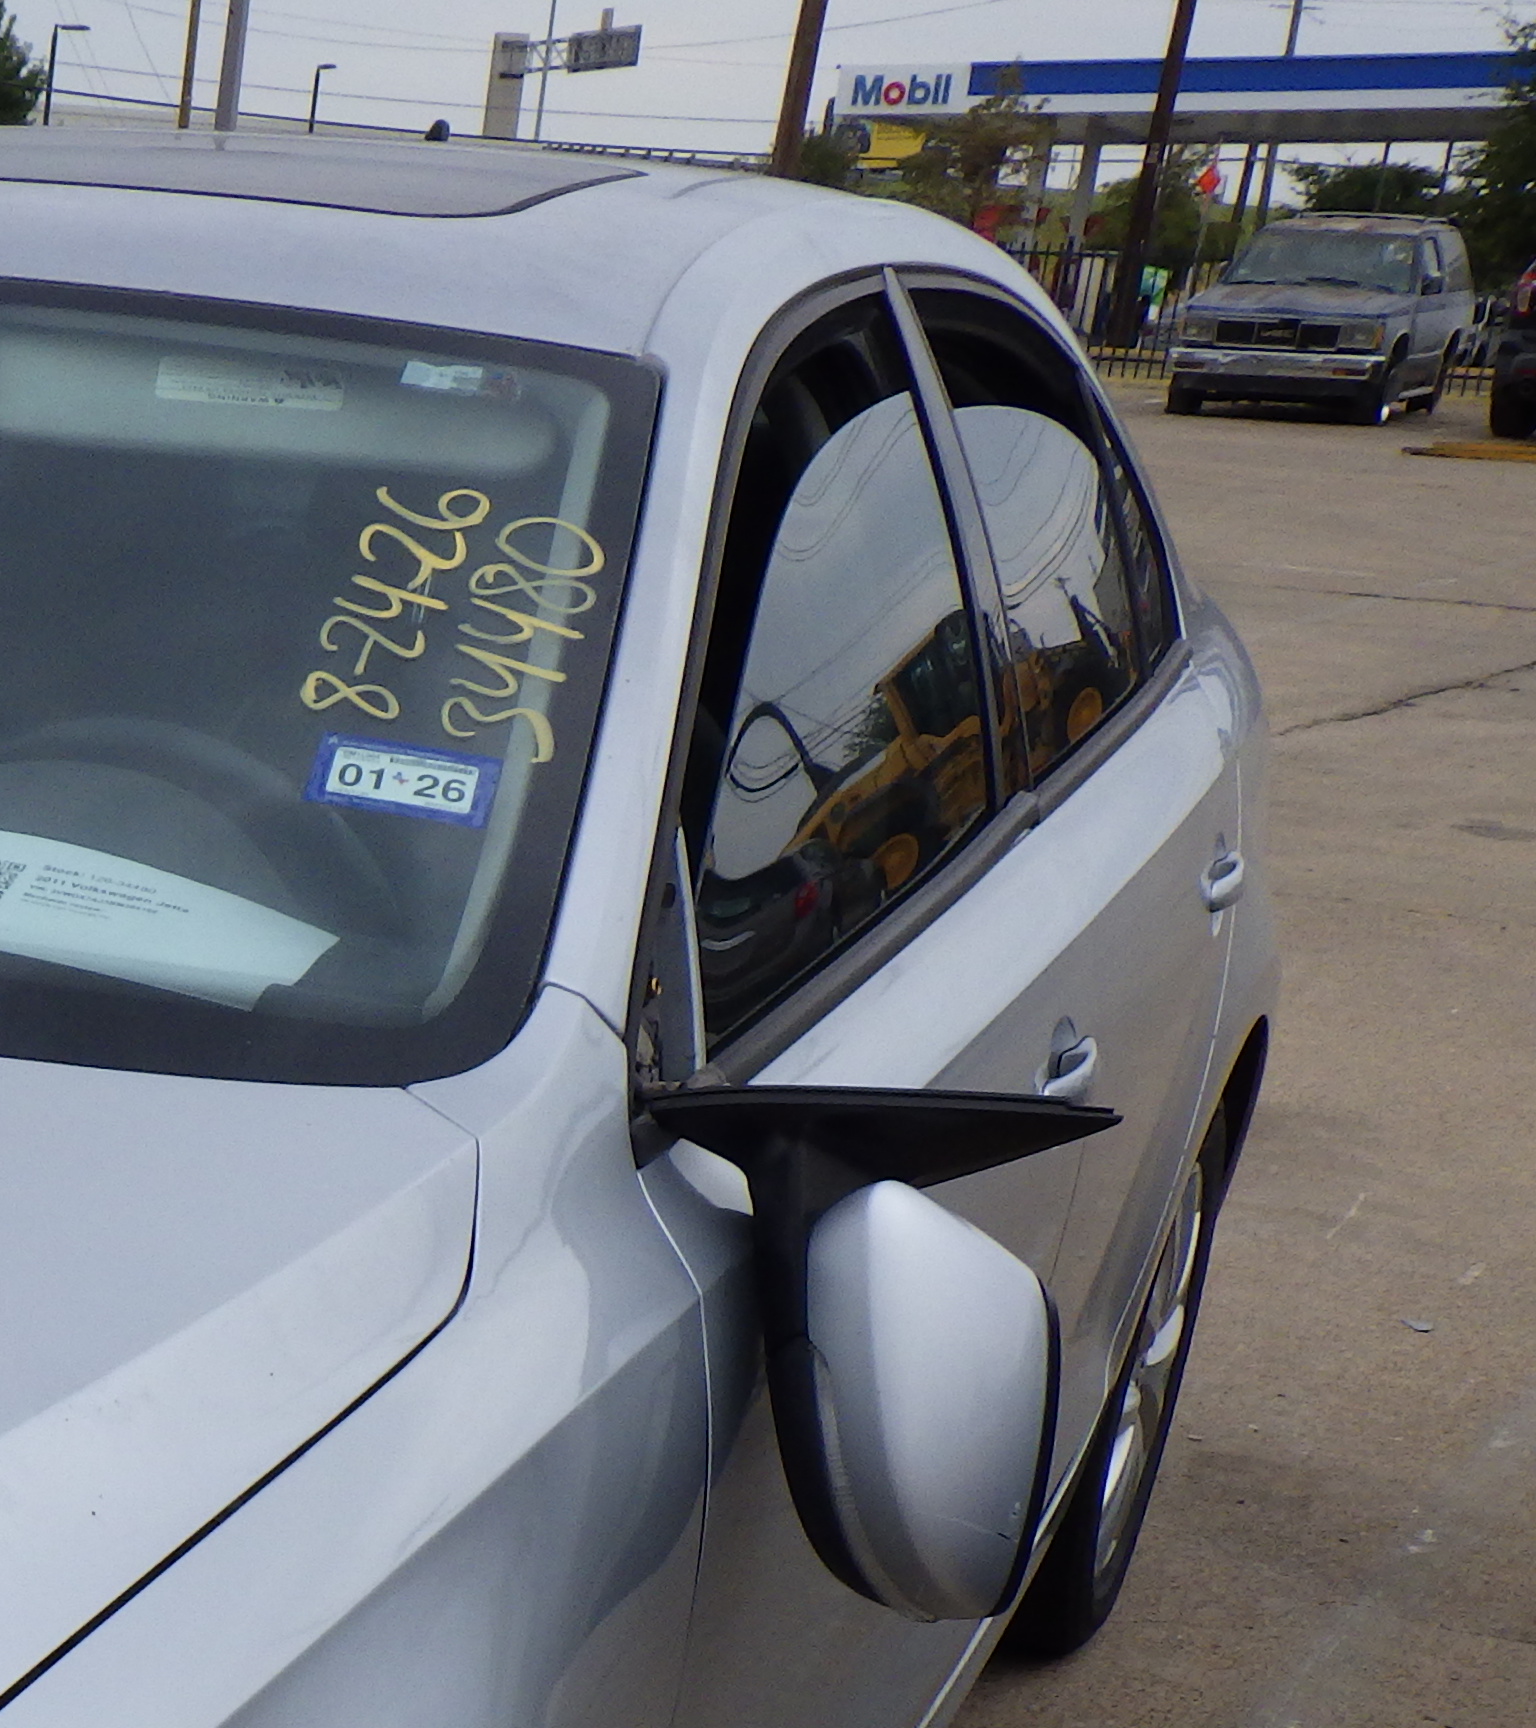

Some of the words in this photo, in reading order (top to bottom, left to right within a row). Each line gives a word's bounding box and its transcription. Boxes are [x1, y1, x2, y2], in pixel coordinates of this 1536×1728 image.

[851, 74, 952, 106] Mobil
[441, 516, 605, 763] 34480
[338, 763, 385, 790] 01
[413, 774, 467, 802] 26
[35, 874, 66, 887] 2011
[71, 882, 153, 904] Volkswagen
[156, 900, 190, 913] Jetta
